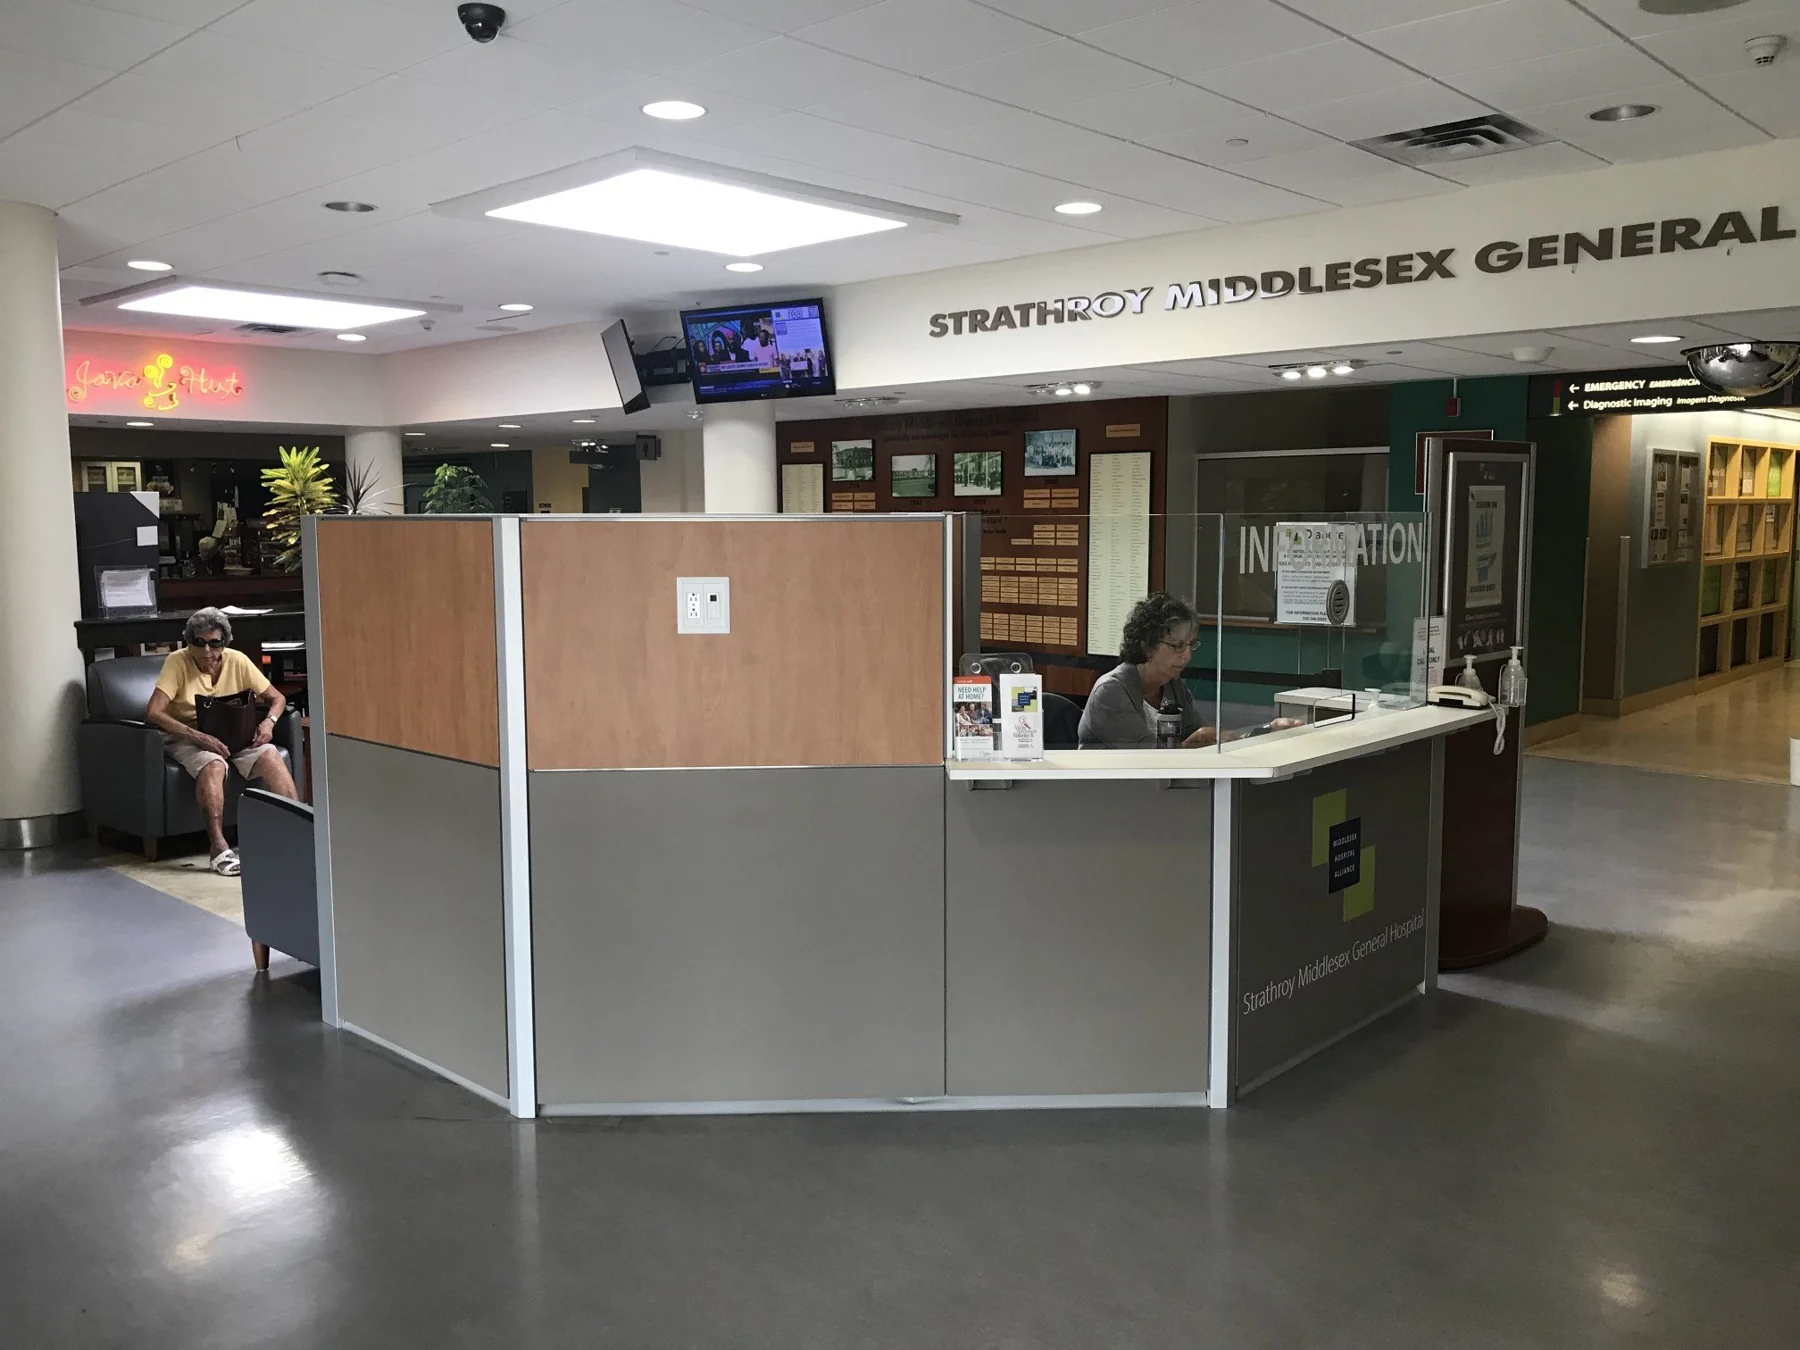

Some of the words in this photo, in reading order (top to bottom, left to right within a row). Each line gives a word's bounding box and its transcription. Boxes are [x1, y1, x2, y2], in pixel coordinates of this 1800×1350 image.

[929, 286, 1154, 339] STRATHROY
[1164, 248, 1456, 311] MIDDLESEX
[1473, 205, 1797, 275] GENERAL
[67, 360, 142, 402] Java
[1584, 380, 1645, 393] EMERGENCY
[1583, 398, 1632, 411] Diagnostic
[1633, 396, 1673, 409] Imaging
[1333, 833, 1357, 847] MIDDLESEX
[1334, 850, 1355, 862] HOSPITAL
[1334, 865, 1355, 878] ALLIANCE
[1243, 975, 1296, 1015] Strathroy
[1298, 950, 1350, 989] Middlesex
[1352, 927, 1388, 961] General
[1389, 910, 1425, 943] Hospital
